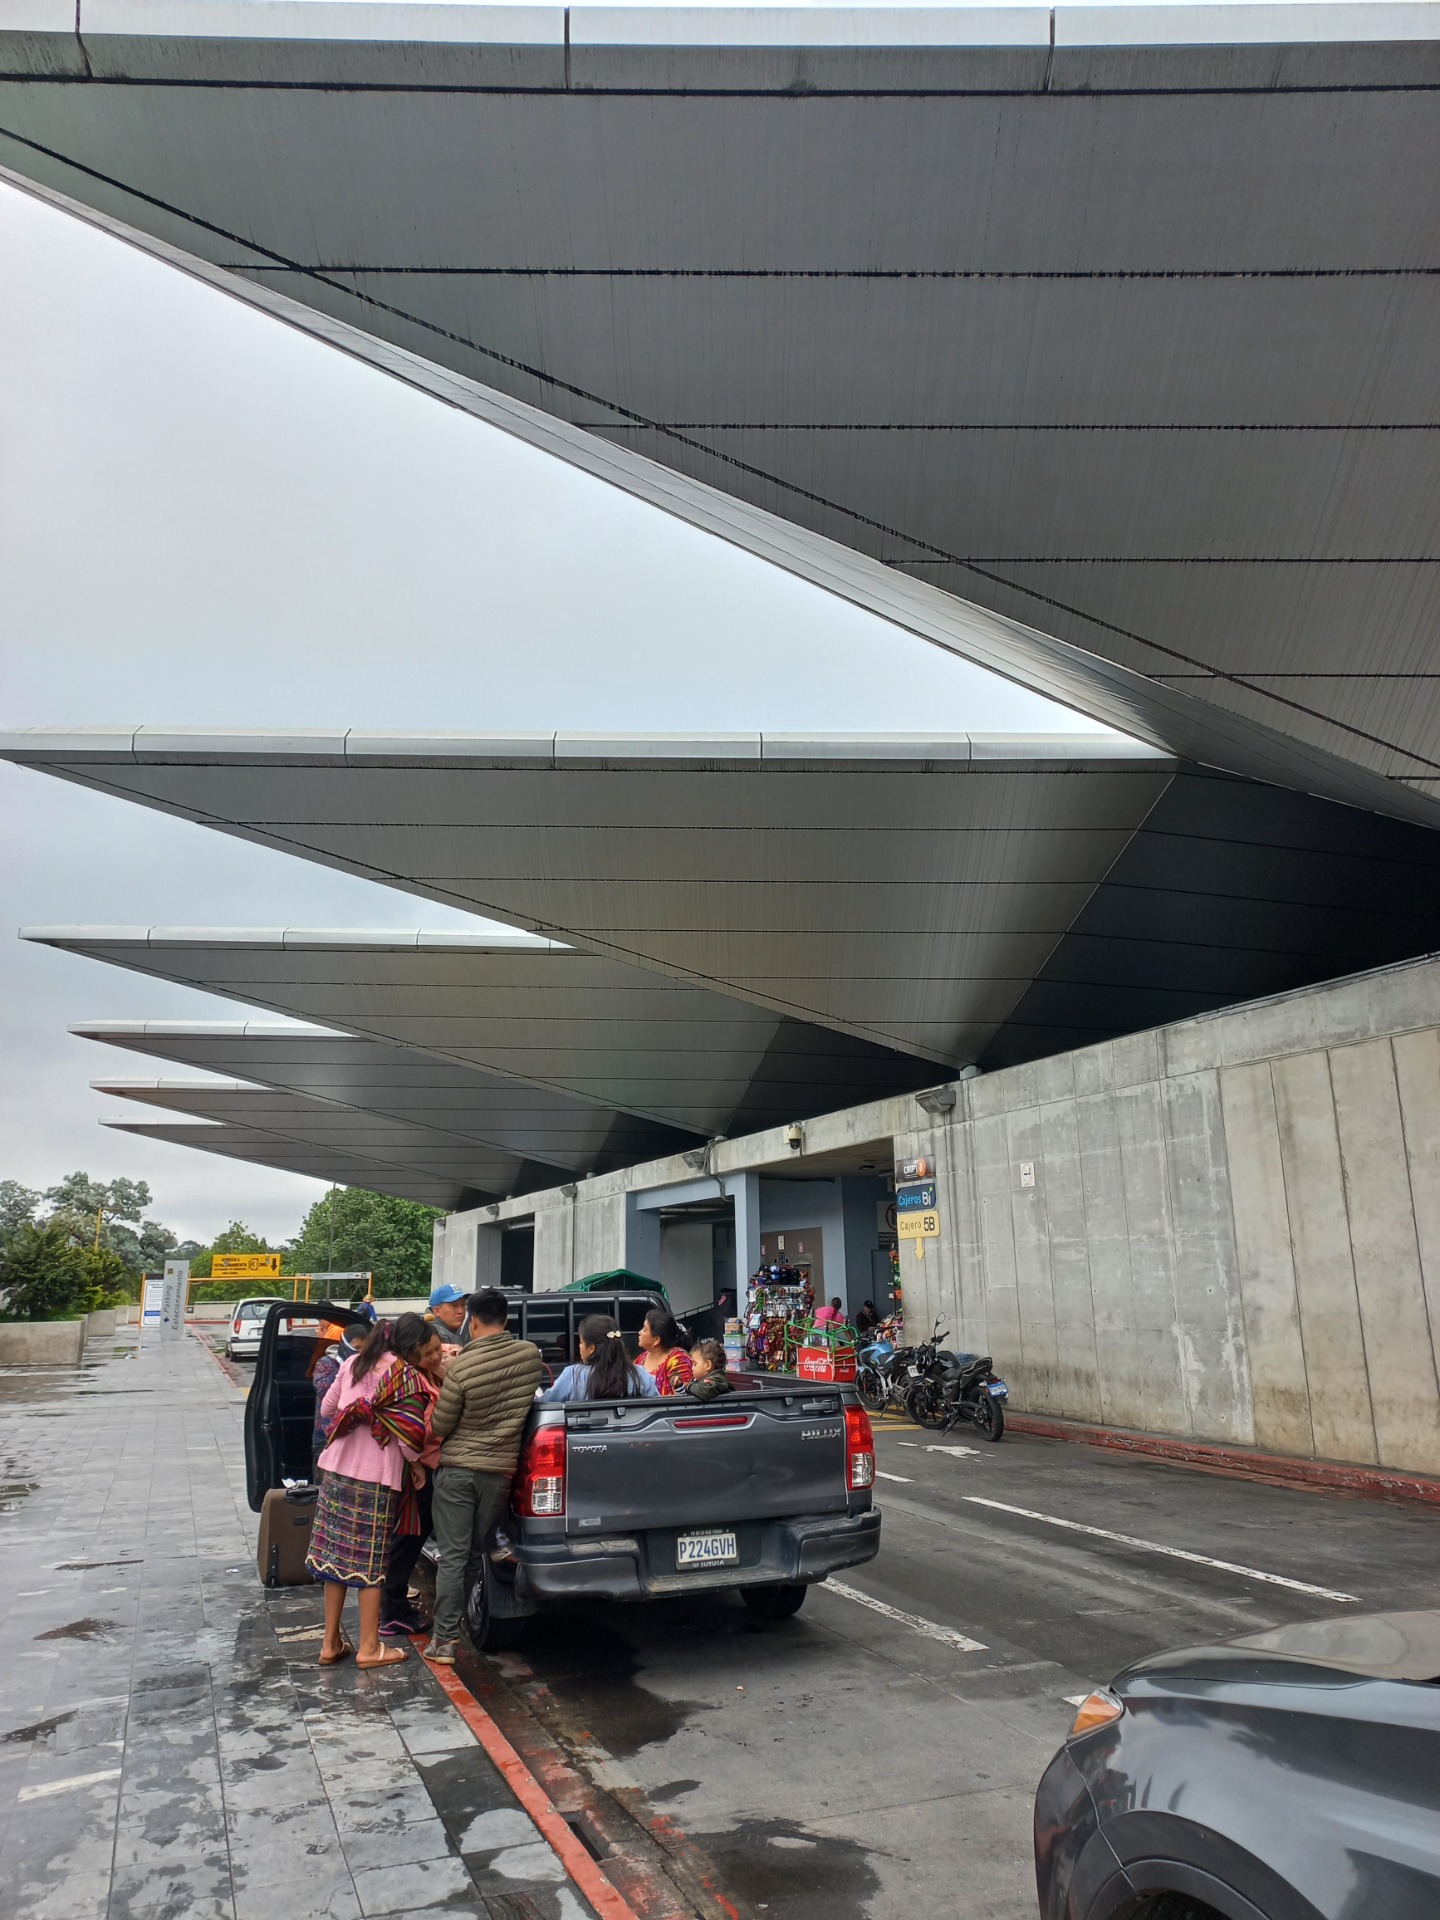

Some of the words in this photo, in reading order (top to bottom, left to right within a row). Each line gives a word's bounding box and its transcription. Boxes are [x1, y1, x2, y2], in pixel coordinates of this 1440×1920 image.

[898, 1194, 922, 1207] Cajeros
[922, 1187, 933, 1206] Bi
[900, 1220, 922, 1232] Cajero
[923, 1216, 935, 1232] 5B
[163, 1285, 173, 1314] Parking
[171, 1270, 184, 1331] Estacionamiento
[801, 1427, 842, 1440] HILUX
[572, 1444, 608, 1453] TOYOTA
[679, 1537, 735, 1559] P224GVH
[700, 1559, 725, 1567] TOYOTA
